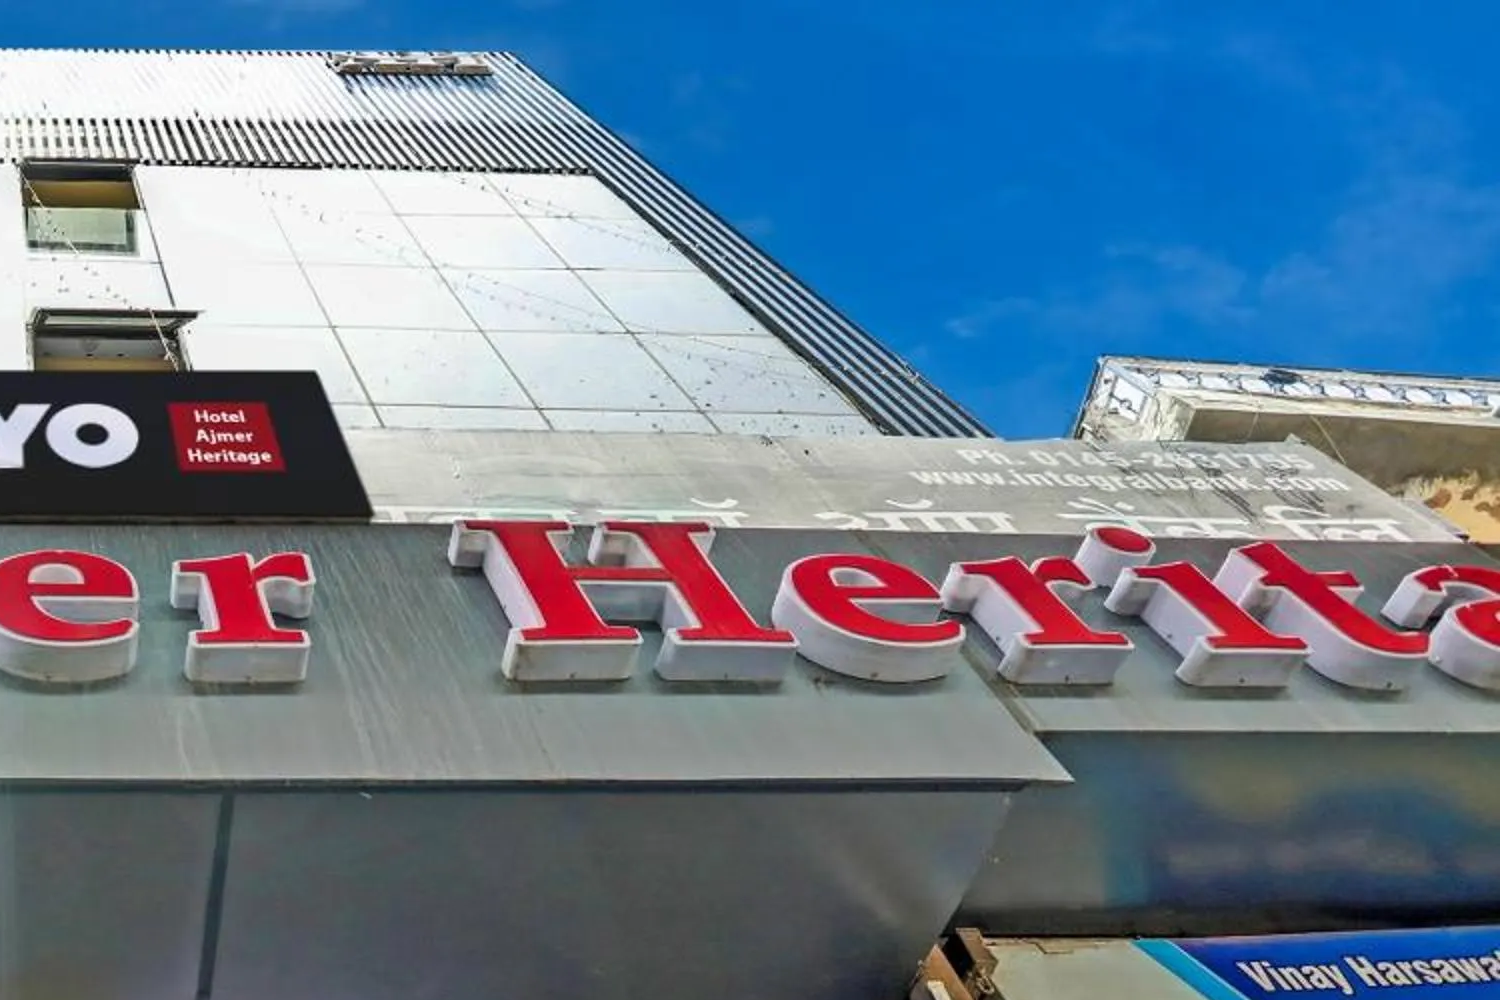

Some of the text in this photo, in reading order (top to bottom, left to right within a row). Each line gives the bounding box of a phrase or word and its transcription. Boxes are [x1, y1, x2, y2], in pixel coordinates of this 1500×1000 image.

[193, 408, 246, 425] Hotel
[195, 429, 254, 445] Ajmer
[186, 447, 273, 465] Heritage
[1236, 951, 1500, 996] Vinay Harsawa
